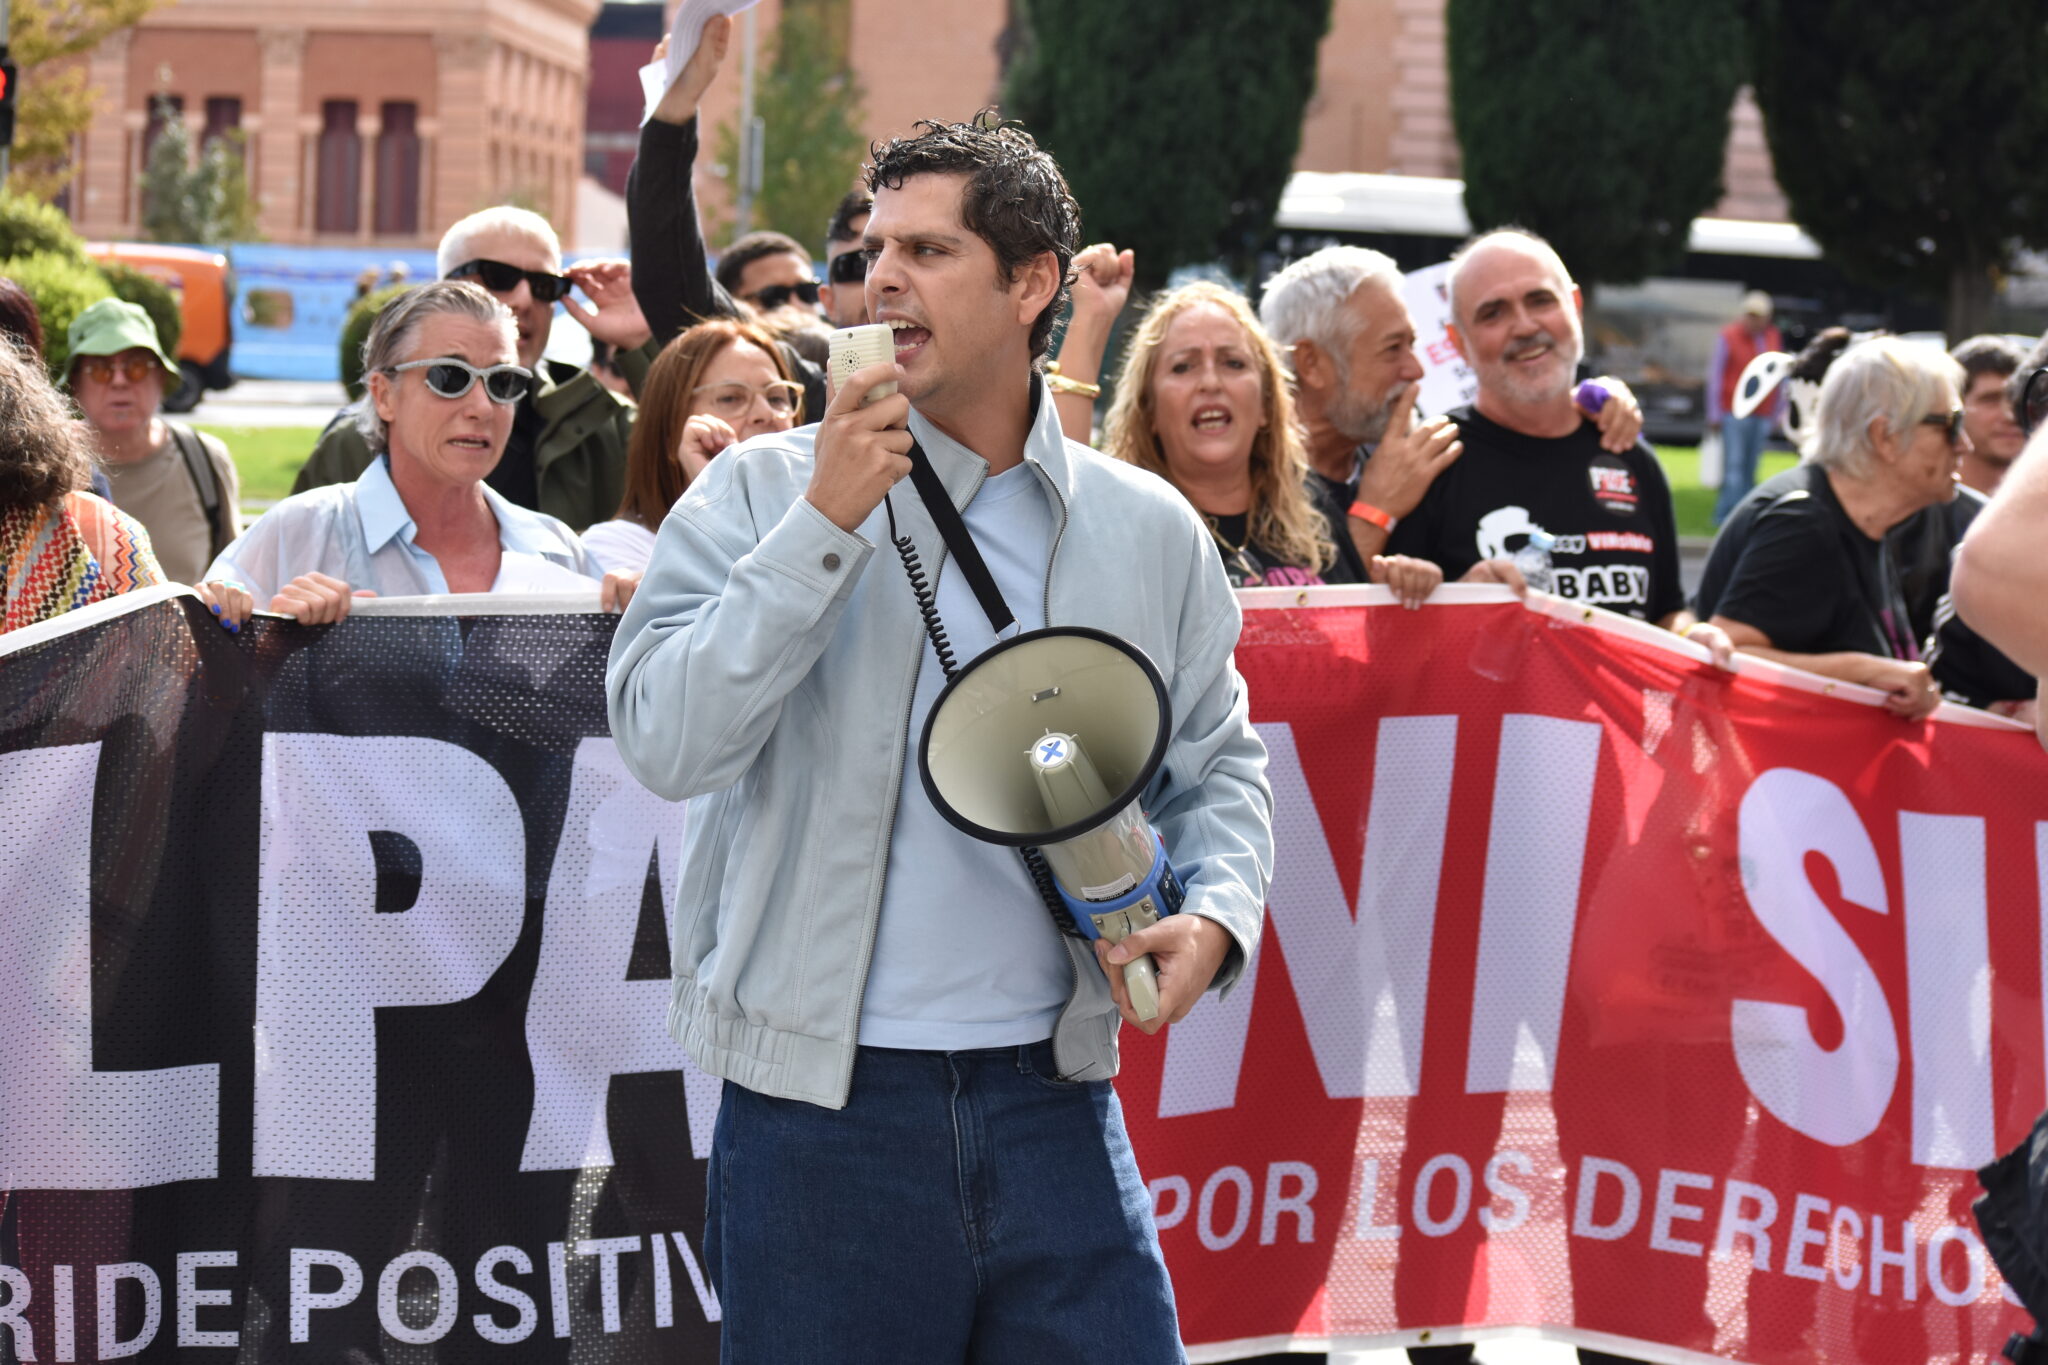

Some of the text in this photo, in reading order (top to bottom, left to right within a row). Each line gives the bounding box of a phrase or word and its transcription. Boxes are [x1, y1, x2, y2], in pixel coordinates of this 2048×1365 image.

[1554, 565, 1650, 604] BABY
[1158, 713, 1602, 1119] NI
[1731, 766, 2048, 1171] SI
[1148, 1151, 2027, 1308] POR LOS DERECHO
